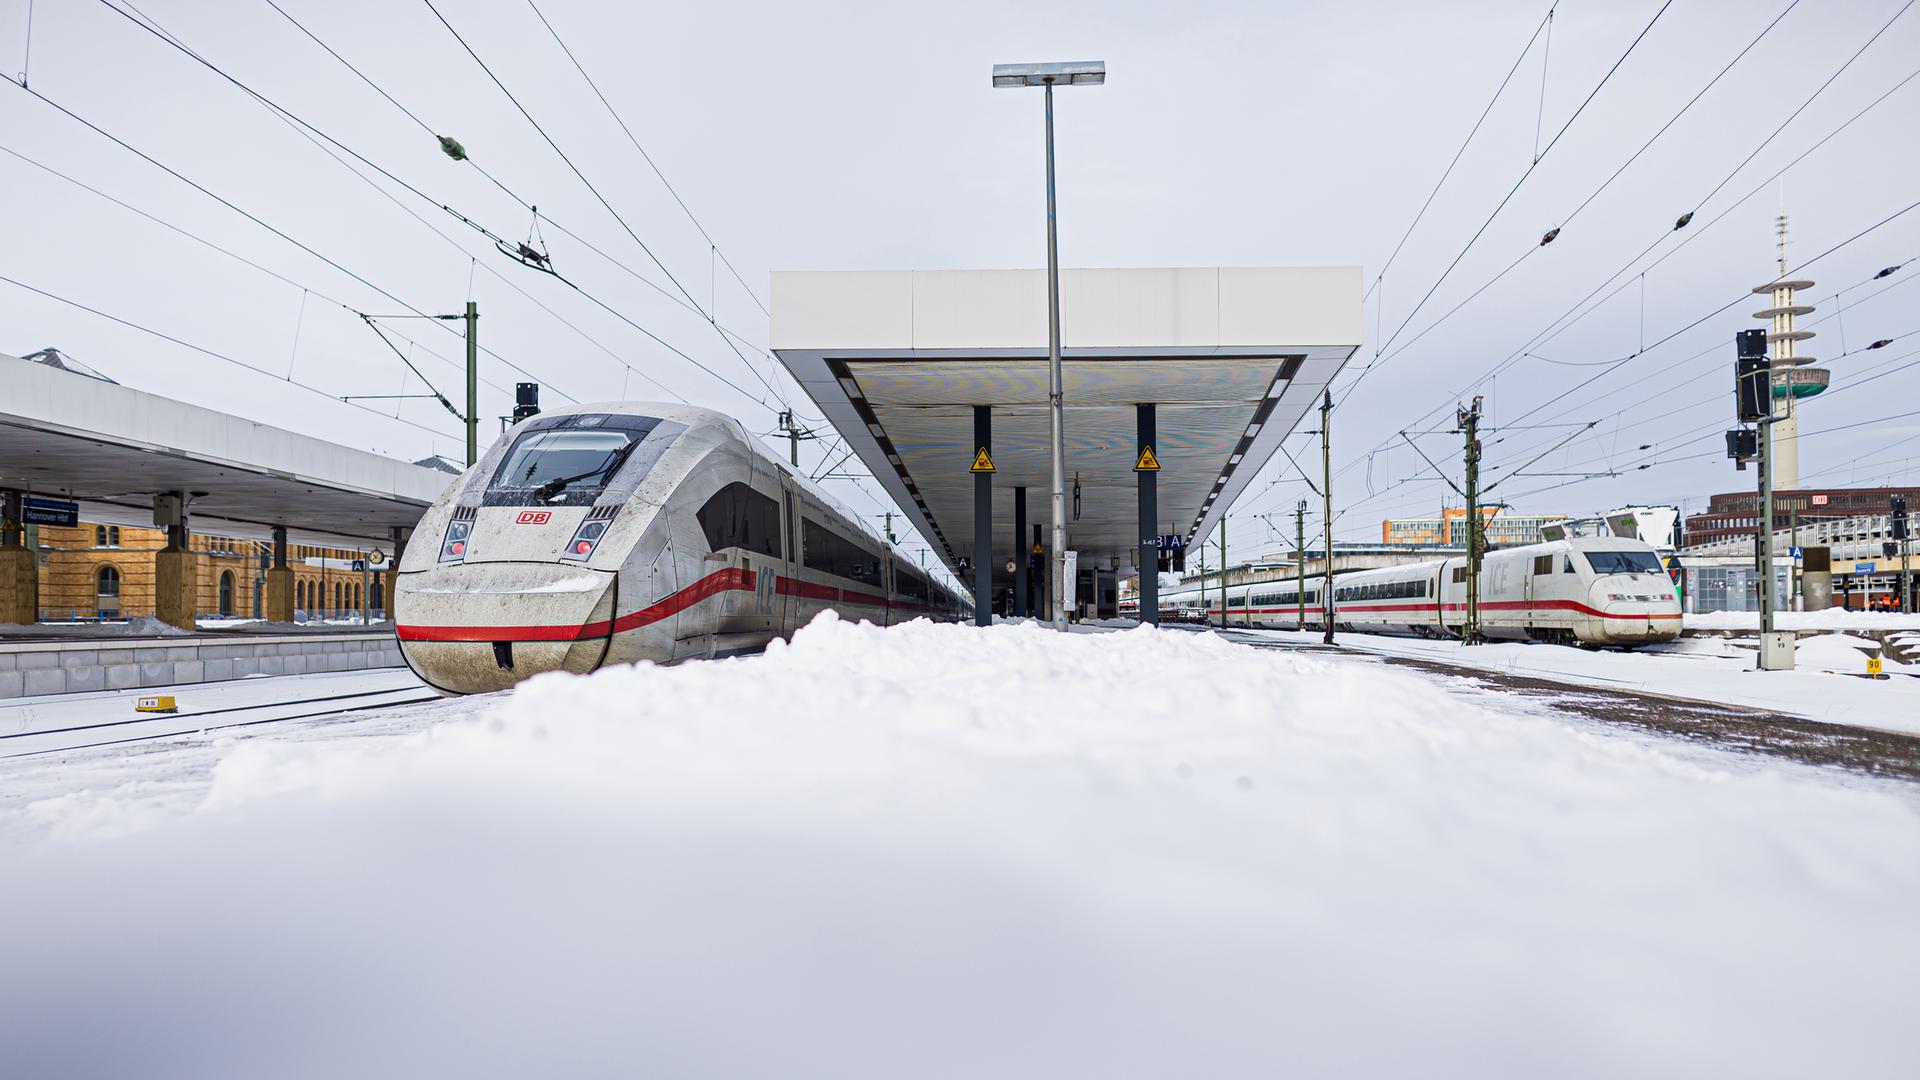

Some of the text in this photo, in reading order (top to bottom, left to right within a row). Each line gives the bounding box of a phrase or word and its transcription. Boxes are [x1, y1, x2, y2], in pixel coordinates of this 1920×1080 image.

[1814, 495, 1827, 504] DB
[27, 510, 69, 522] Hannover Hbf
[519, 513, 547, 523] DB
[1171, 536, 1181, 547] A
[1794, 546, 1802, 556] A
[354, 562, 362, 570] A
[959, 558, 967, 567] A
[1489, 563, 1509, 594] ICE
[756, 565, 775, 614] ICE
